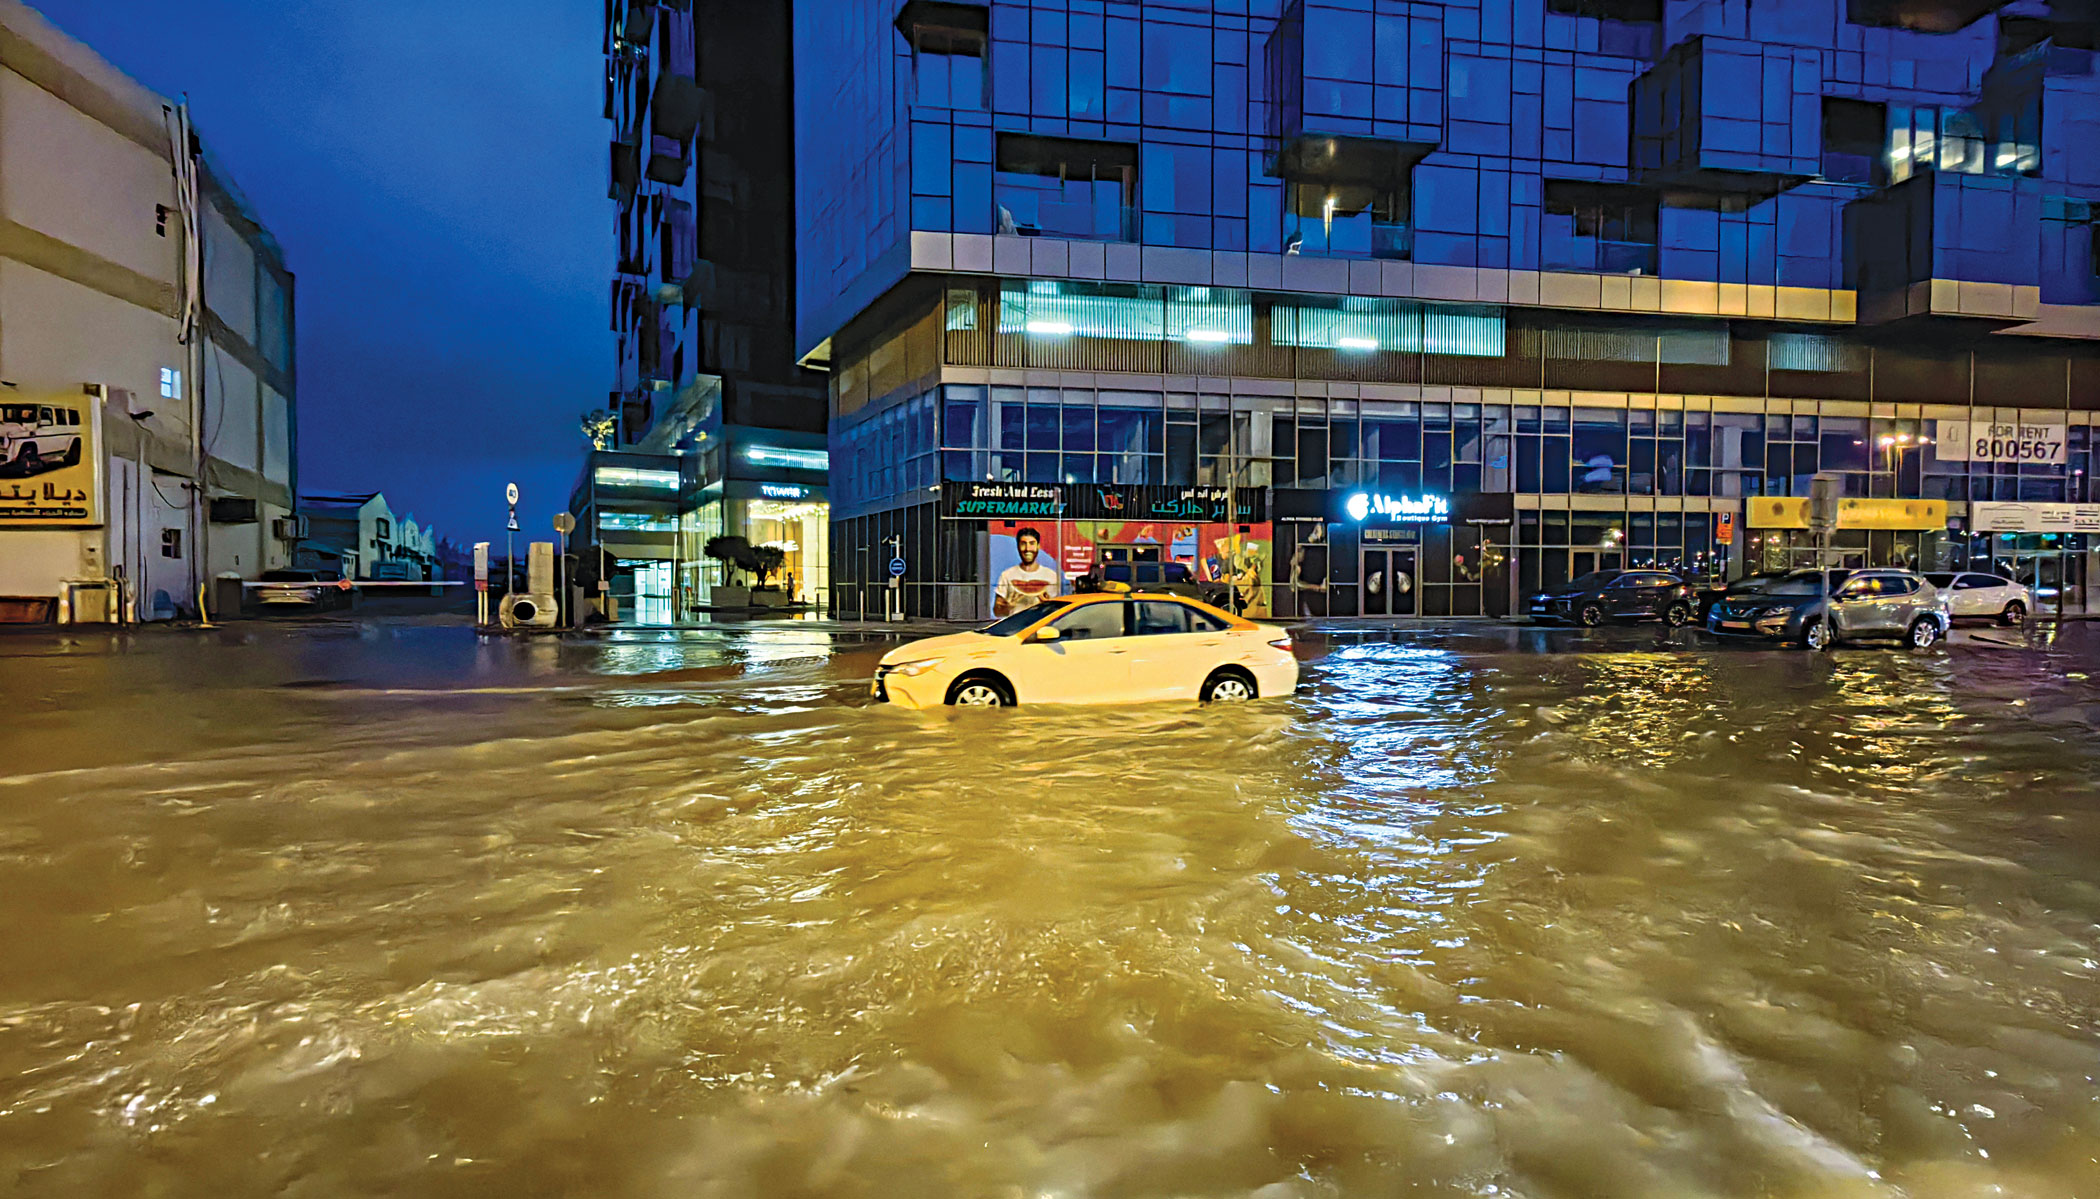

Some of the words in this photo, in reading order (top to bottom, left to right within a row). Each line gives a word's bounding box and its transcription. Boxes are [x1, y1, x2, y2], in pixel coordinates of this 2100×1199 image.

[1988, 426, 2013, 437] FOR
[1975, 439, 2061, 459] 800567
[972, 485, 1002, 498] Fresh
[1030, 487, 1054, 498] Less
[1431, 514, 1448, 522] Gym
[1721, 512, 1729, 524] P
